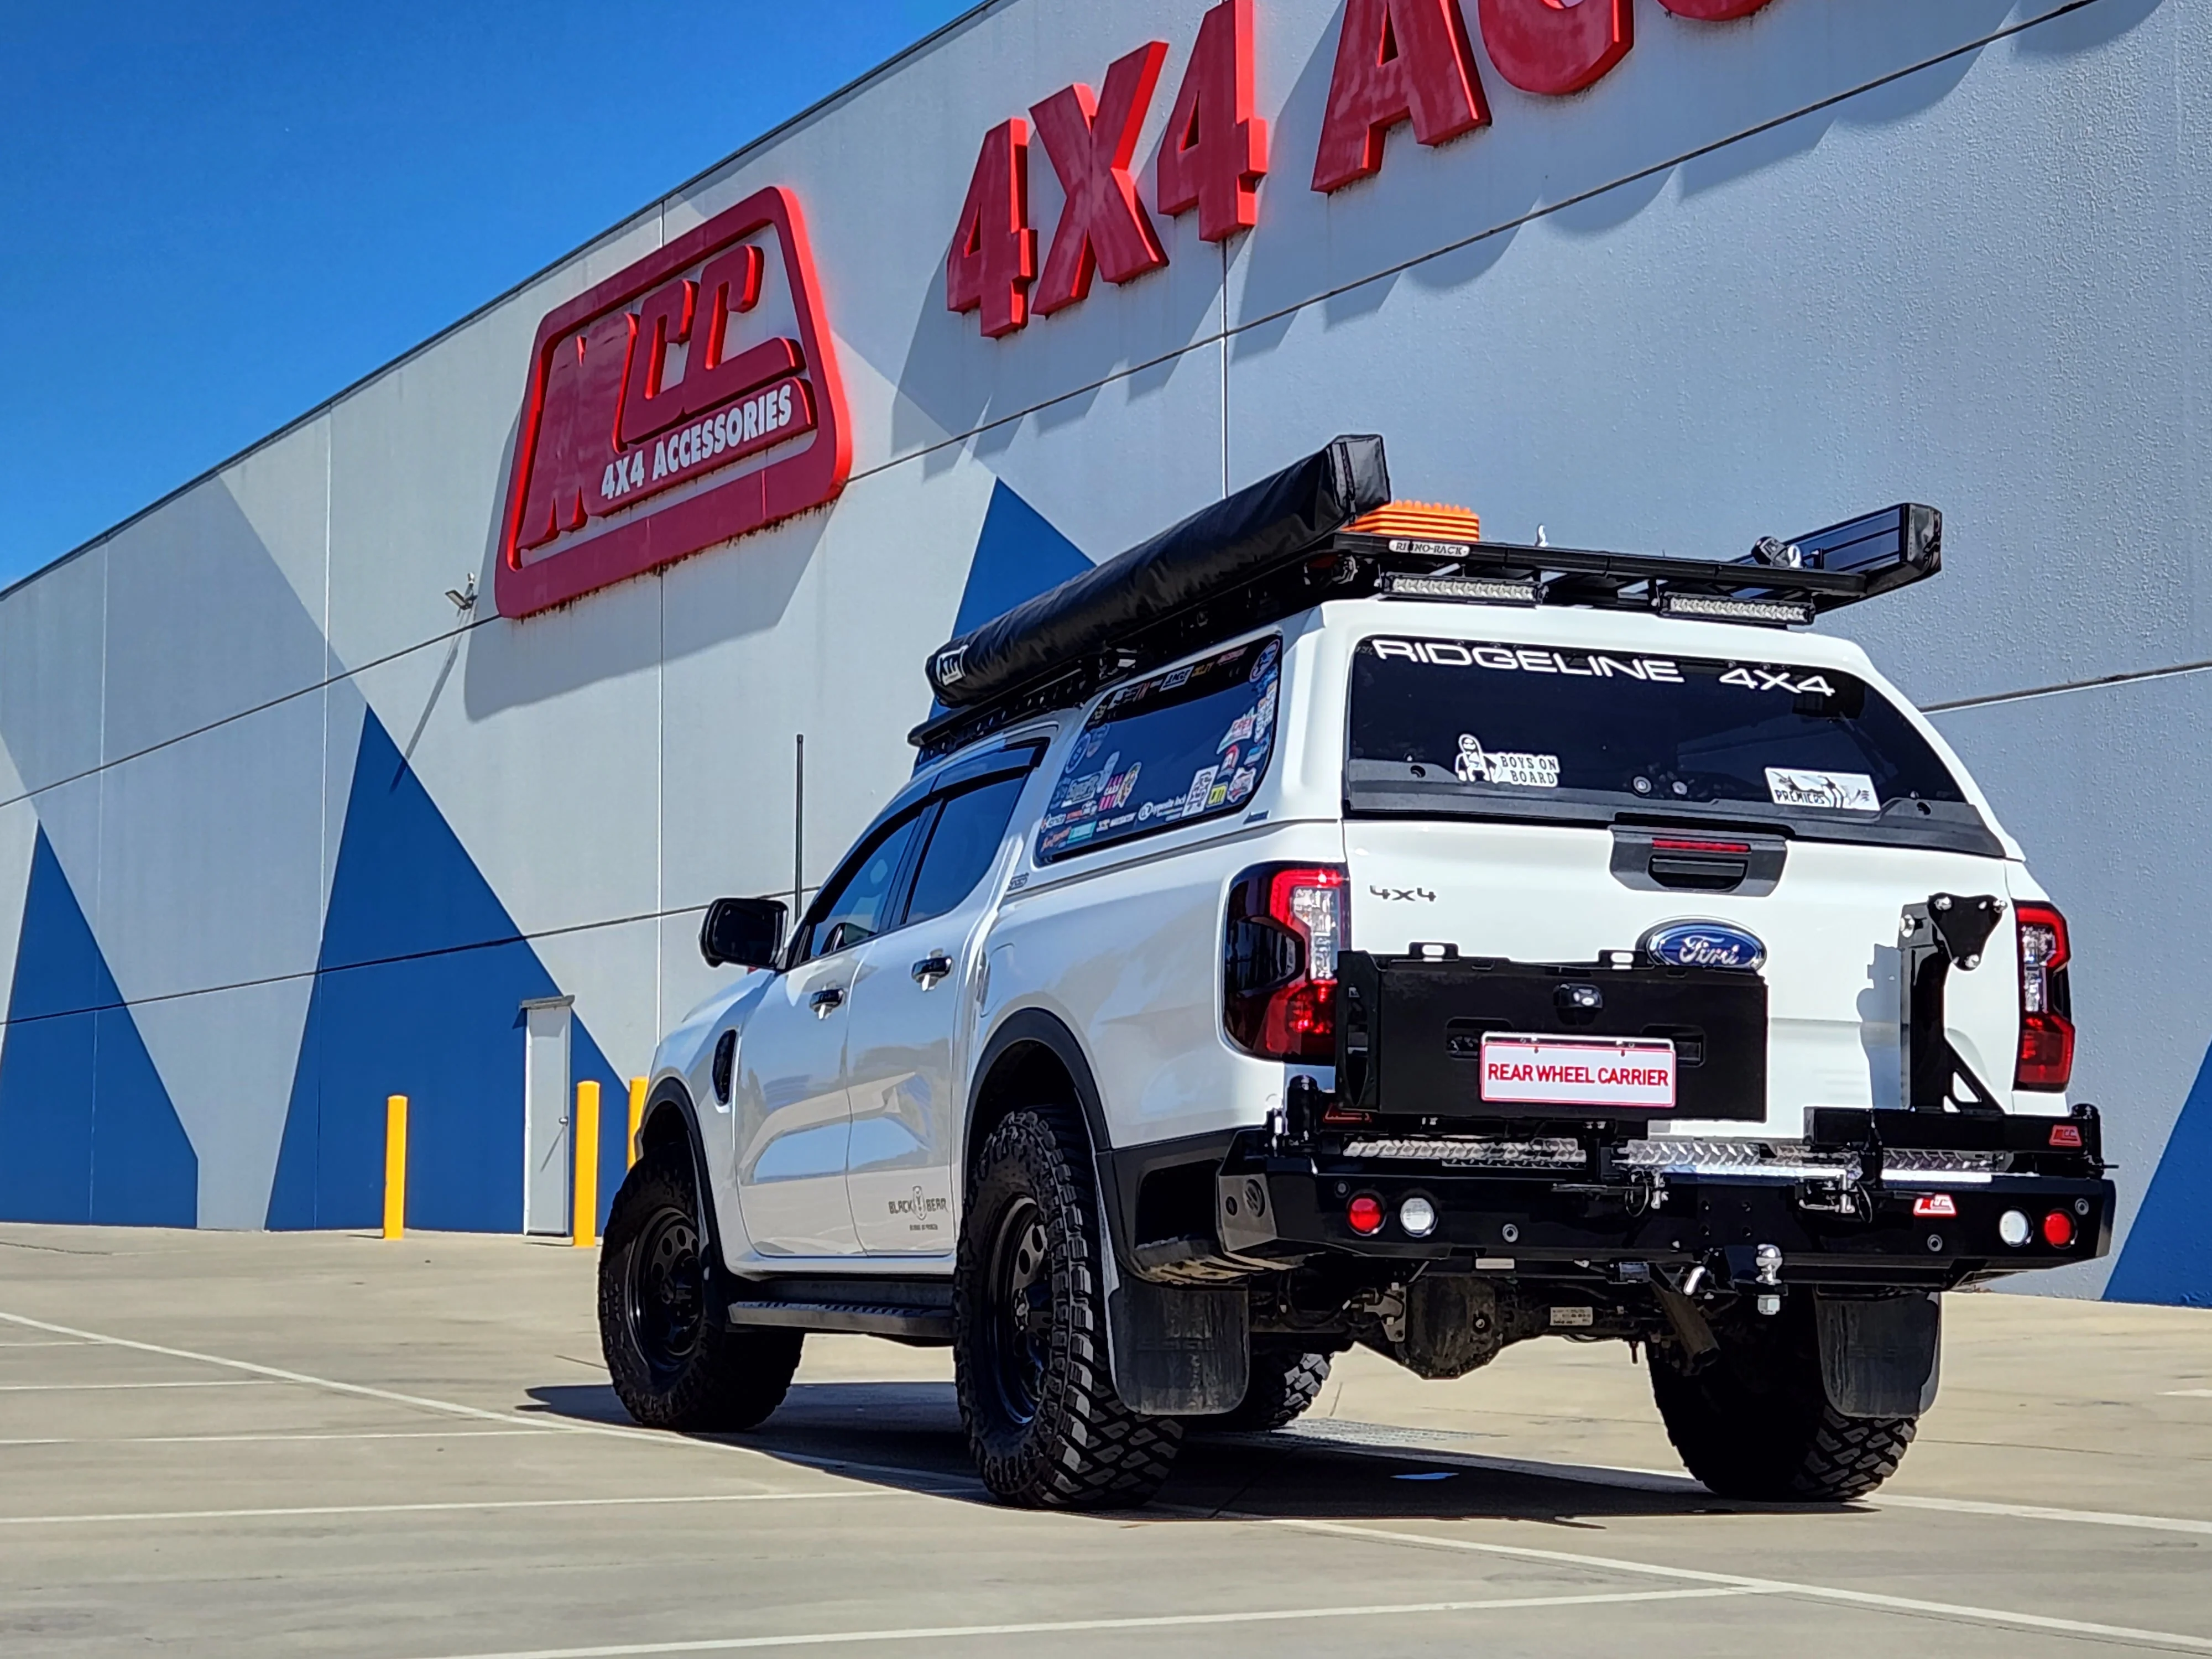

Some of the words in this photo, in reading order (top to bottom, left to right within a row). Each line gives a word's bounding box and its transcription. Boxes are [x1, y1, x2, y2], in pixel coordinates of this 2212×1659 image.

[947, 0, 1266, 338] 4X4
[516, 244, 807, 550] MCC
[601, 450, 644, 500] 4X4
[653, 384, 791, 481] ACCESSORIES
[1395, 542, 1463, 555] RNO-RACK
[1371, 639, 1685, 683] RIDGELINE
[1718, 667, 1835, 697] 4X4
[1500, 755, 1535, 769] BOYS
[1539, 758, 1557, 770] ON
[1510, 770, 1555, 784] BOARD
[1679, 935, 1740, 965] Ford
[1488, 1063, 1534, 1082] REAR
[1536, 1065, 1596, 1084] WHEEL
[1598, 1067, 1670, 1087] CARRIER
[888, 1200, 913, 1214] BLACK
[926, 1198, 949, 1213] BEAR
